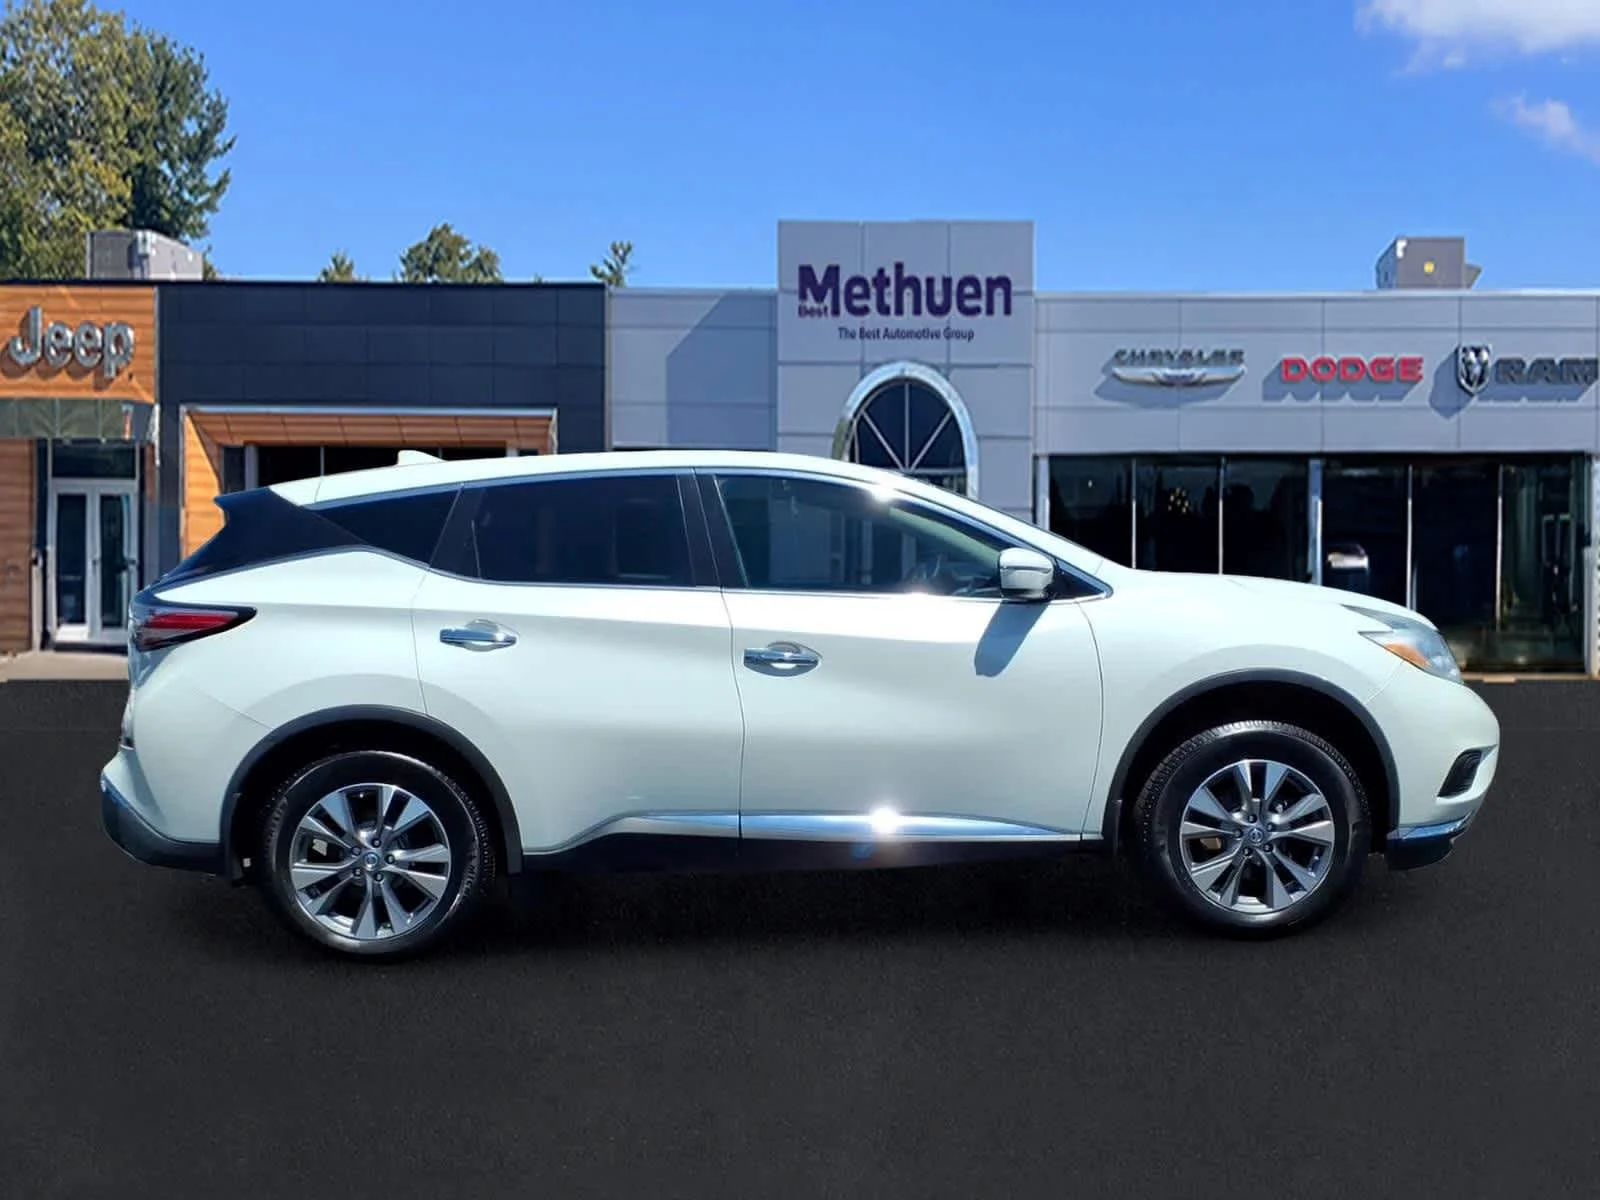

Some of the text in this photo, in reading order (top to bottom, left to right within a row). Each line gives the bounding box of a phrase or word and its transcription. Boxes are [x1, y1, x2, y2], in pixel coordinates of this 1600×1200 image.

[798, 262, 1012, 317] Methuen
[9, 304, 135, 378] Jeep
[838, 326, 975, 342] The Best Automotive Group
[1280, 356, 1424, 382] DODGE
[1496, 357, 1599, 385] RAM
